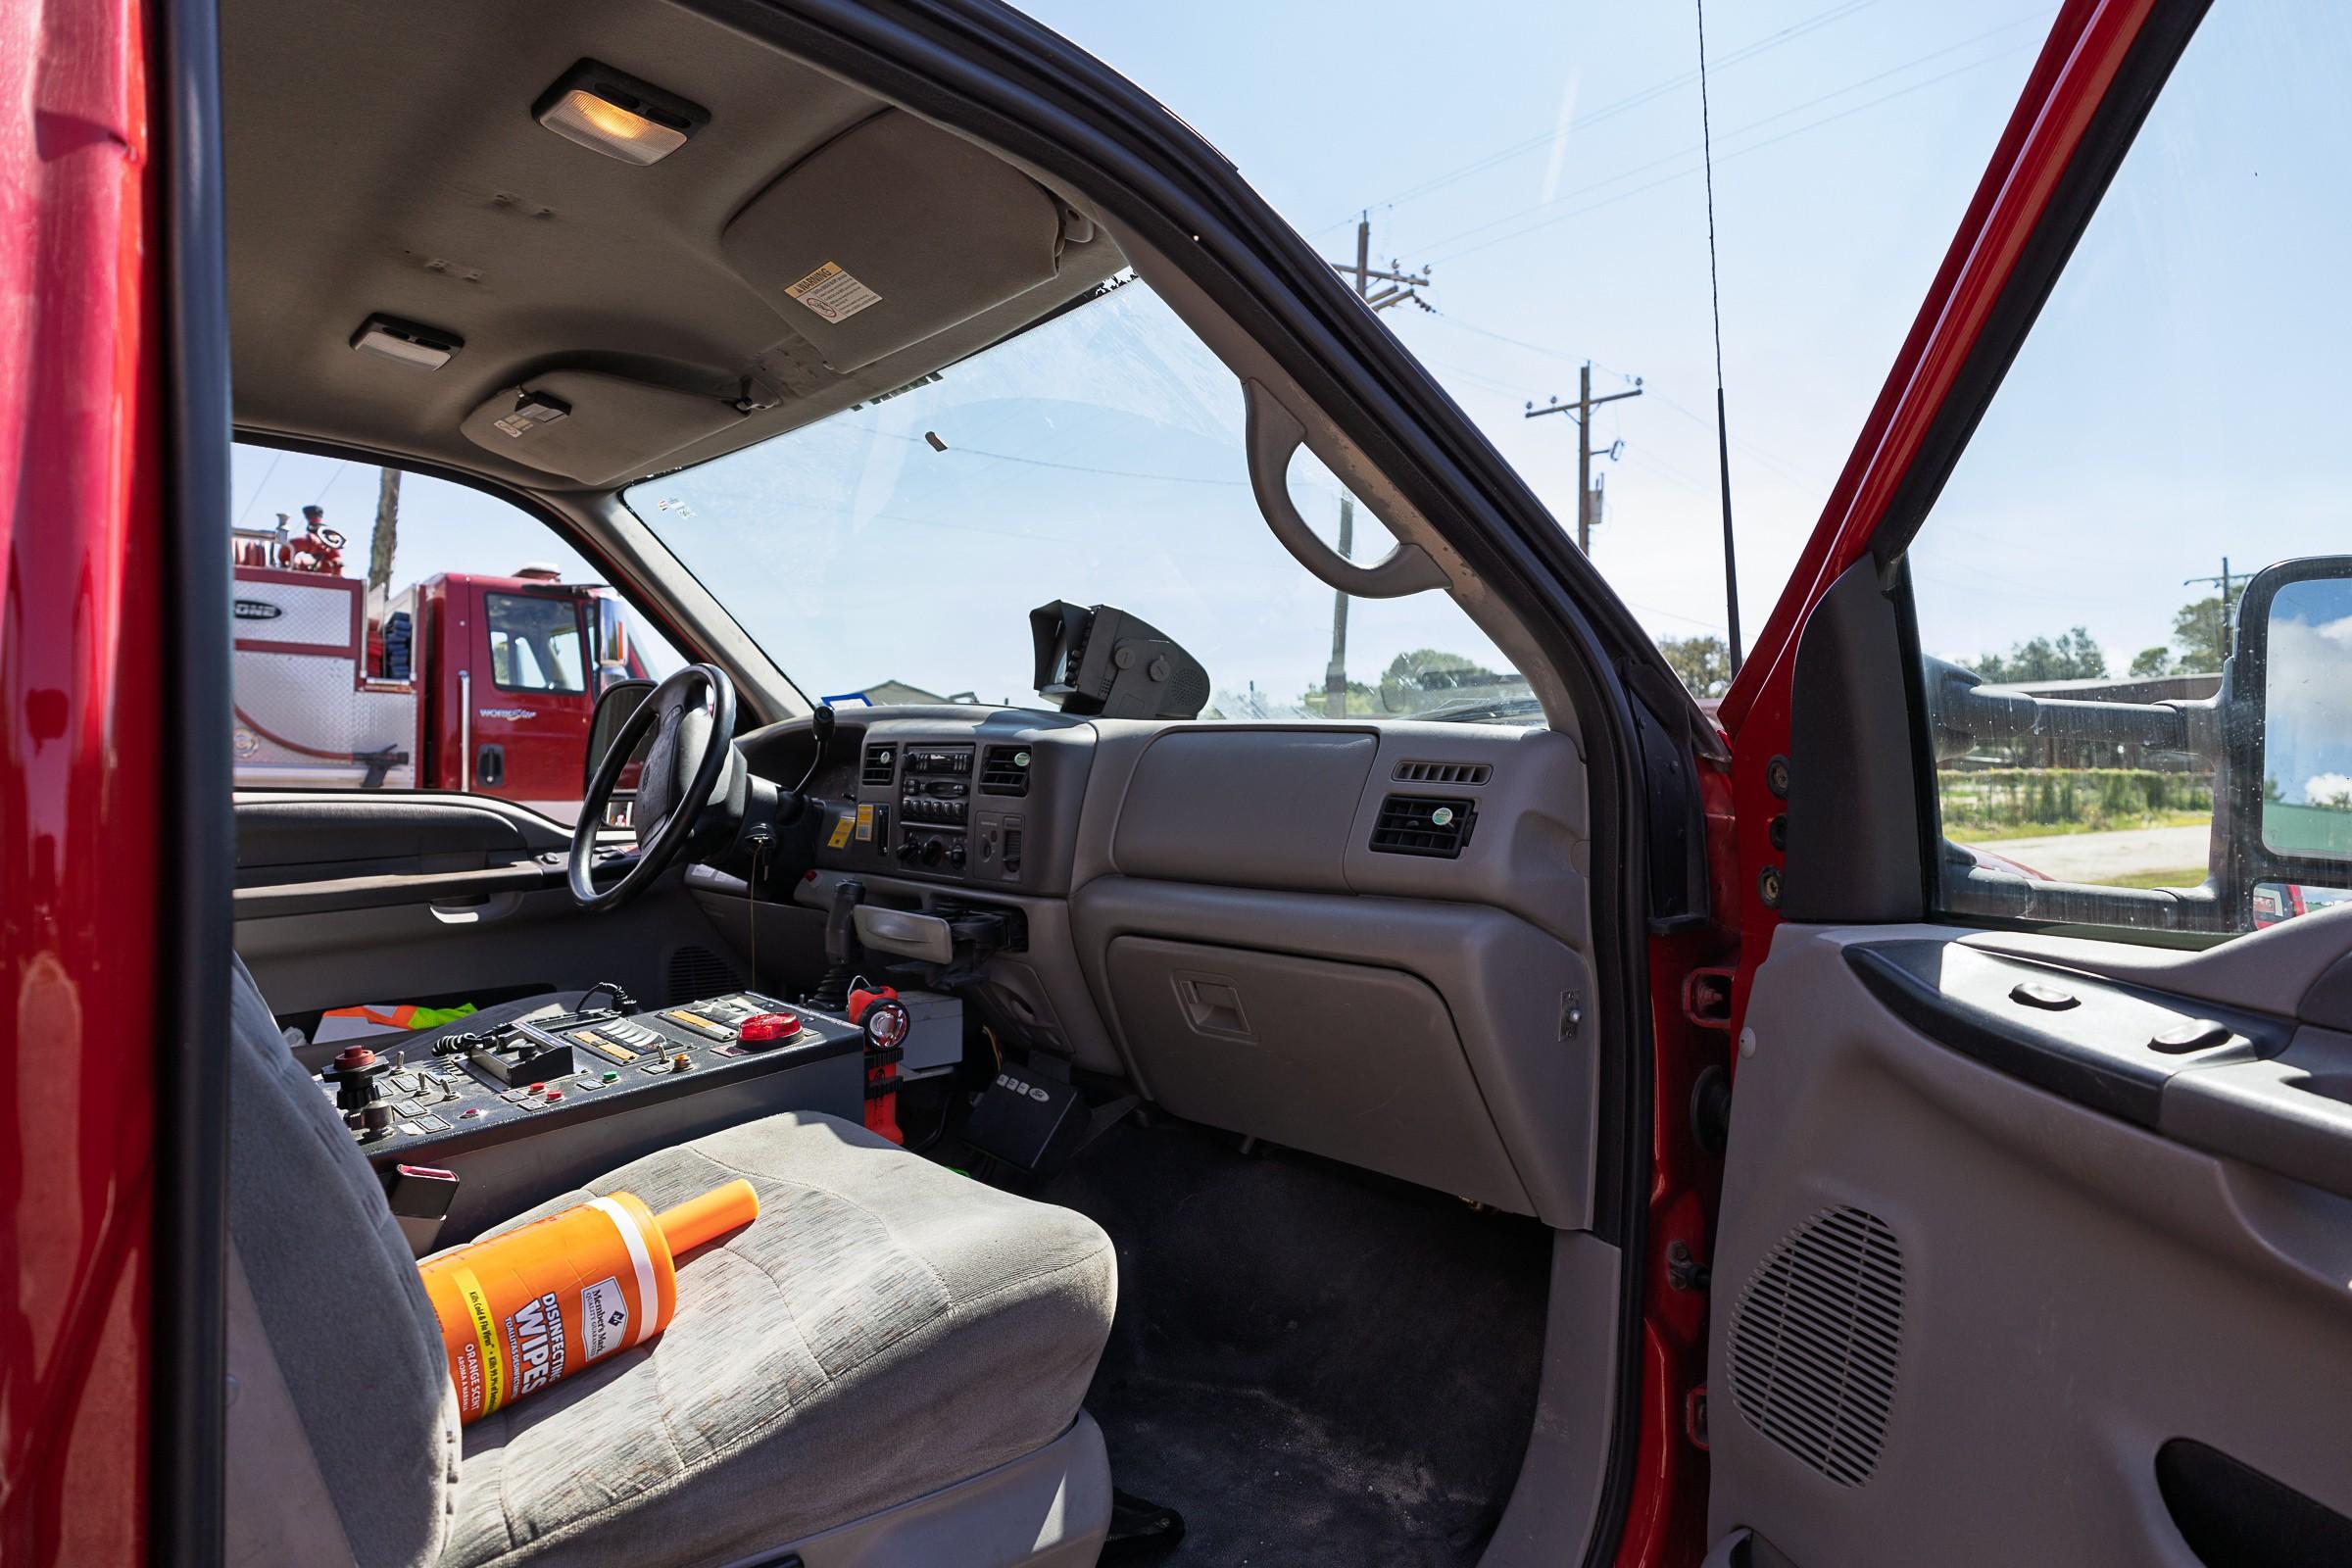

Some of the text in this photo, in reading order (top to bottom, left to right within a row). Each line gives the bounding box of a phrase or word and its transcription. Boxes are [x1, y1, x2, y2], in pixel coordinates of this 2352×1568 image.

[799, 268, 832, 290] WARNING
[474, 1303, 484, 1315] Cold
[586, 1292, 596, 1320] QUALITY
[593, 1289, 607, 1333] Member's
[505, 1316, 518, 1355] TOALLITAS
[514, 1298, 550, 1395] WIPES
[541, 1292, 564, 1383] DISINFECTING
[457, 1355, 467, 1378] AROMA
[466, 1344, 481, 1411] ORANGE SCENT
